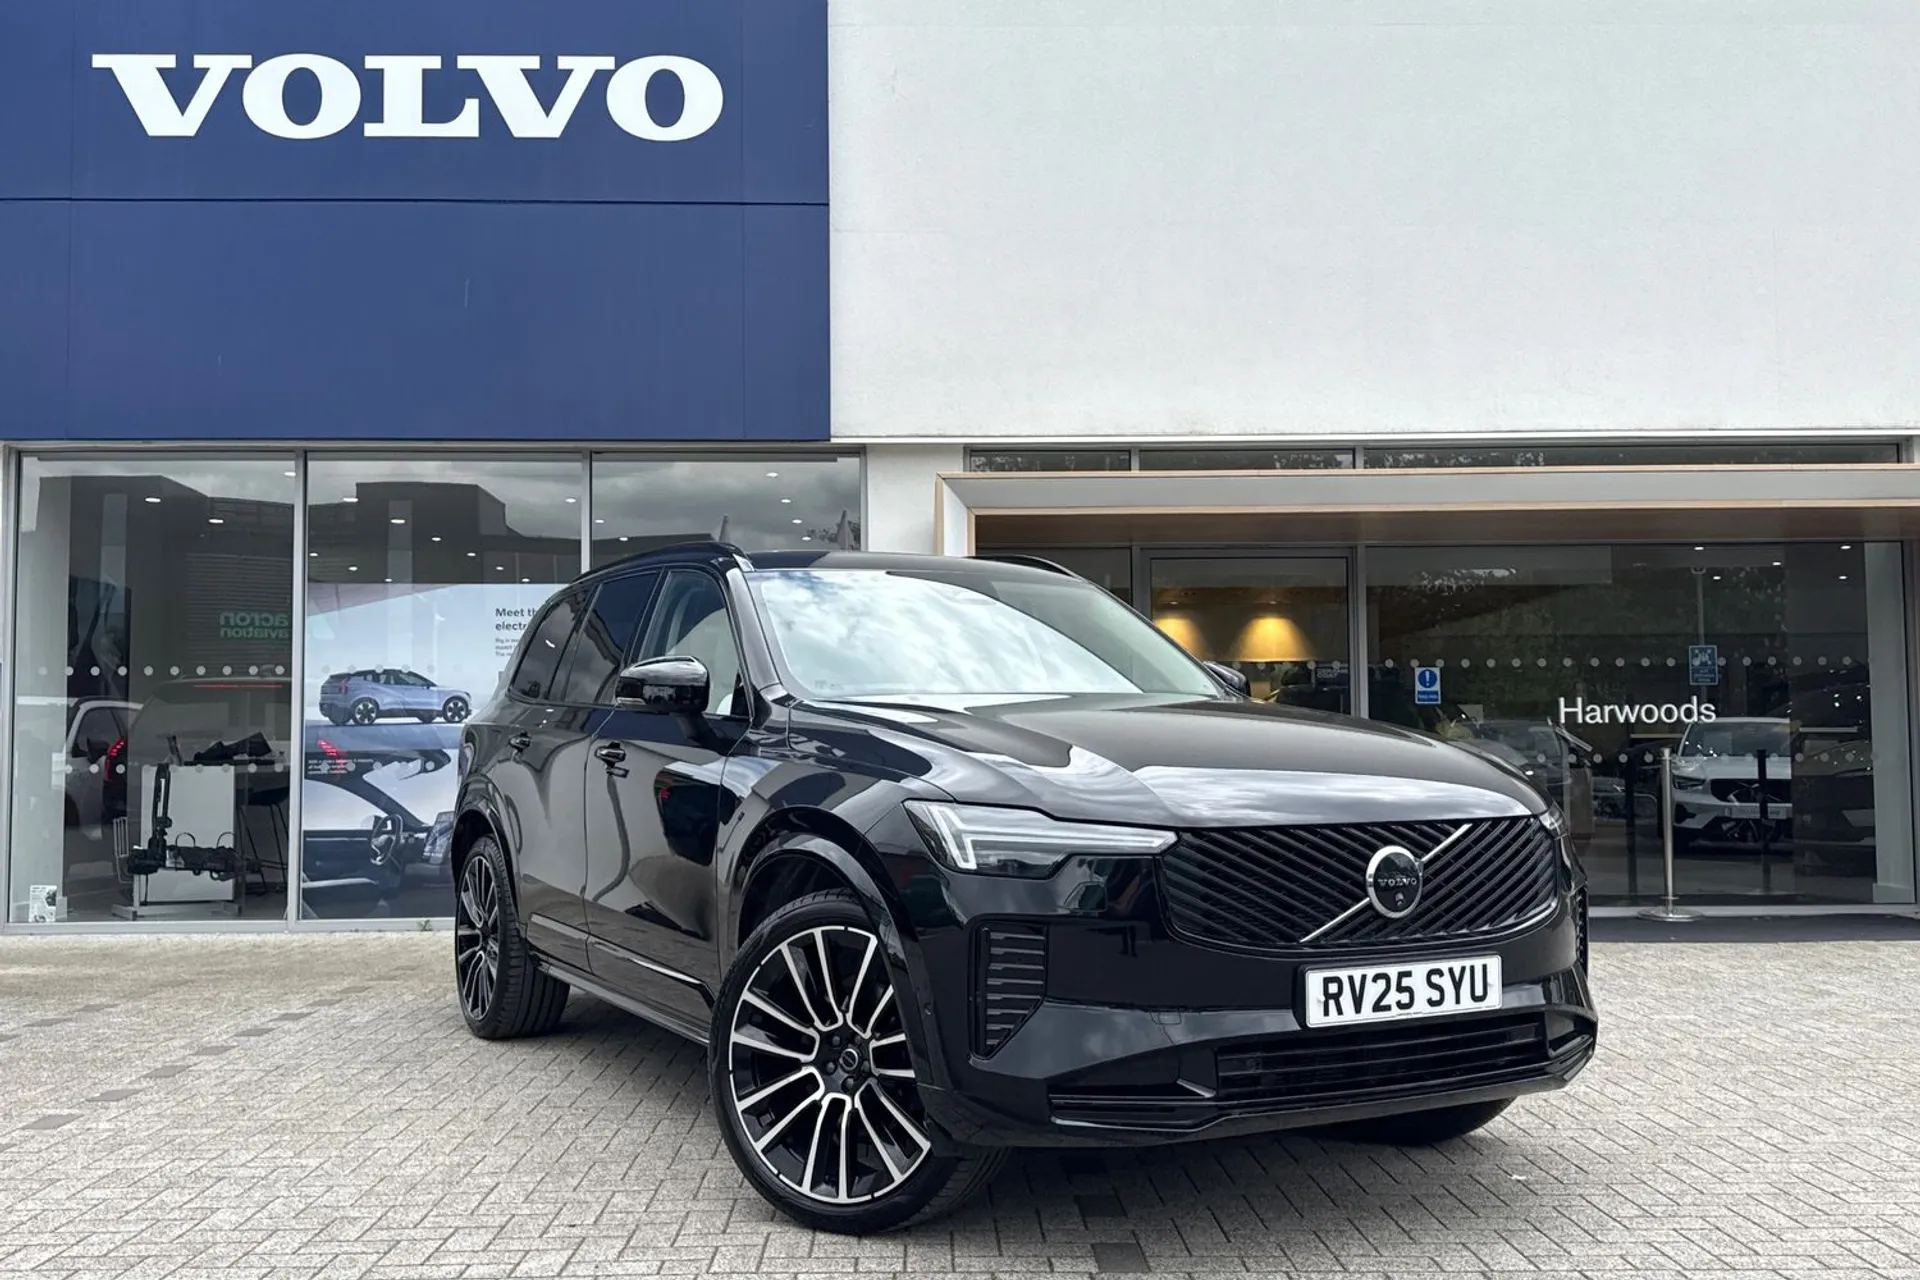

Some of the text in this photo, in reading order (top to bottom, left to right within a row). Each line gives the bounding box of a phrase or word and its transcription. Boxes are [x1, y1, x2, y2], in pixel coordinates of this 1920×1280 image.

[92, 53, 723, 141] VOLVO
[495, 607, 525, 617] Meet
[1558, 695, 1717, 724] Harwoods
[1377, 877, 1418, 887] VOLVO
[1322, 963, 1489, 1017] RV25 SYU
